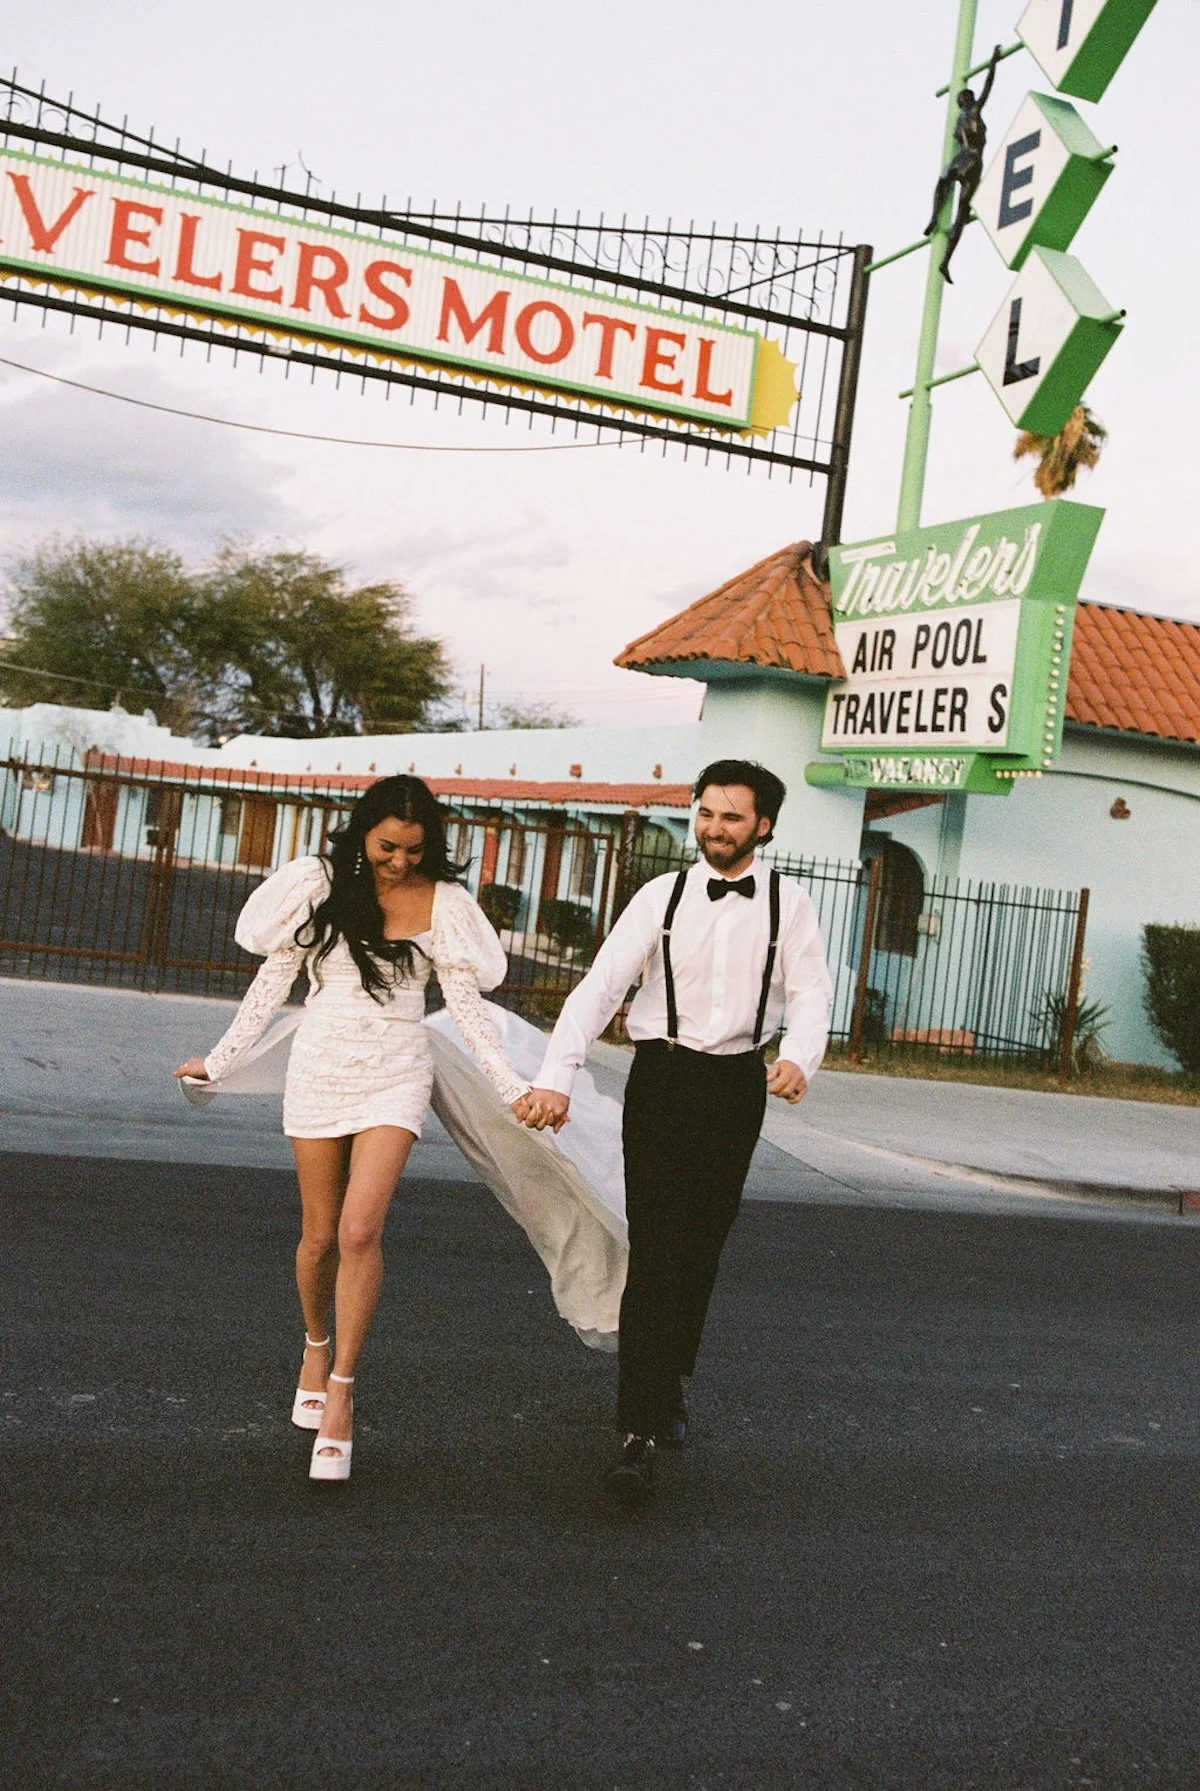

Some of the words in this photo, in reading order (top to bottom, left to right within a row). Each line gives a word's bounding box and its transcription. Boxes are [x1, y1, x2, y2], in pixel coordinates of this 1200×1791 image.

[0, 171, 414, 332] VELERS
[437, 276, 733, 407] MOTEL
[836, 523, 1042, 616] Travelers
[852, 629, 896, 674] AIR
[912, 618, 987, 669] POOL
[832, 687, 969, 735] TRAVELER
[988, 683, 1008, 733] S
[871, 756, 966, 786] VACANCY
